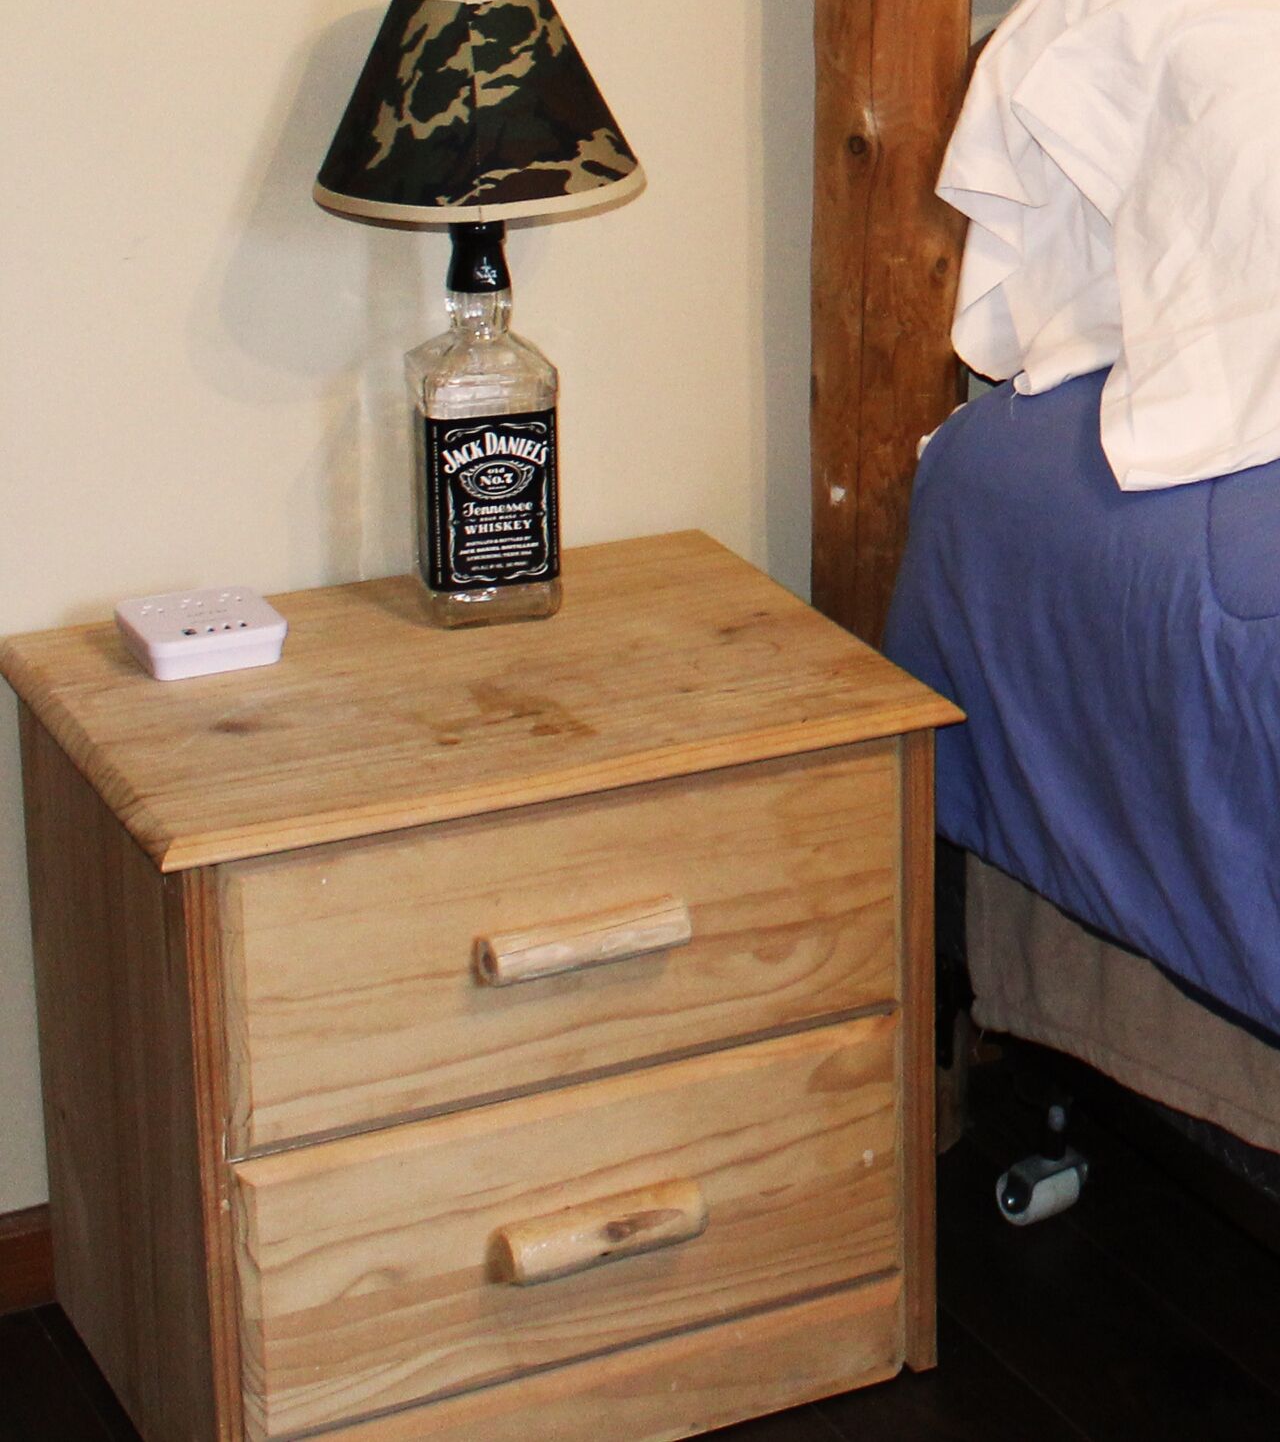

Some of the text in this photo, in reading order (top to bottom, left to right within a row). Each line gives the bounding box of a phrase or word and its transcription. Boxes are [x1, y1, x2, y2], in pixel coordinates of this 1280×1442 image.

[442, 431, 549, 474] JACK DANIEL'S
[462, 501, 534, 518] Tennessee
[464, 518, 533, 535] WHISKEY
